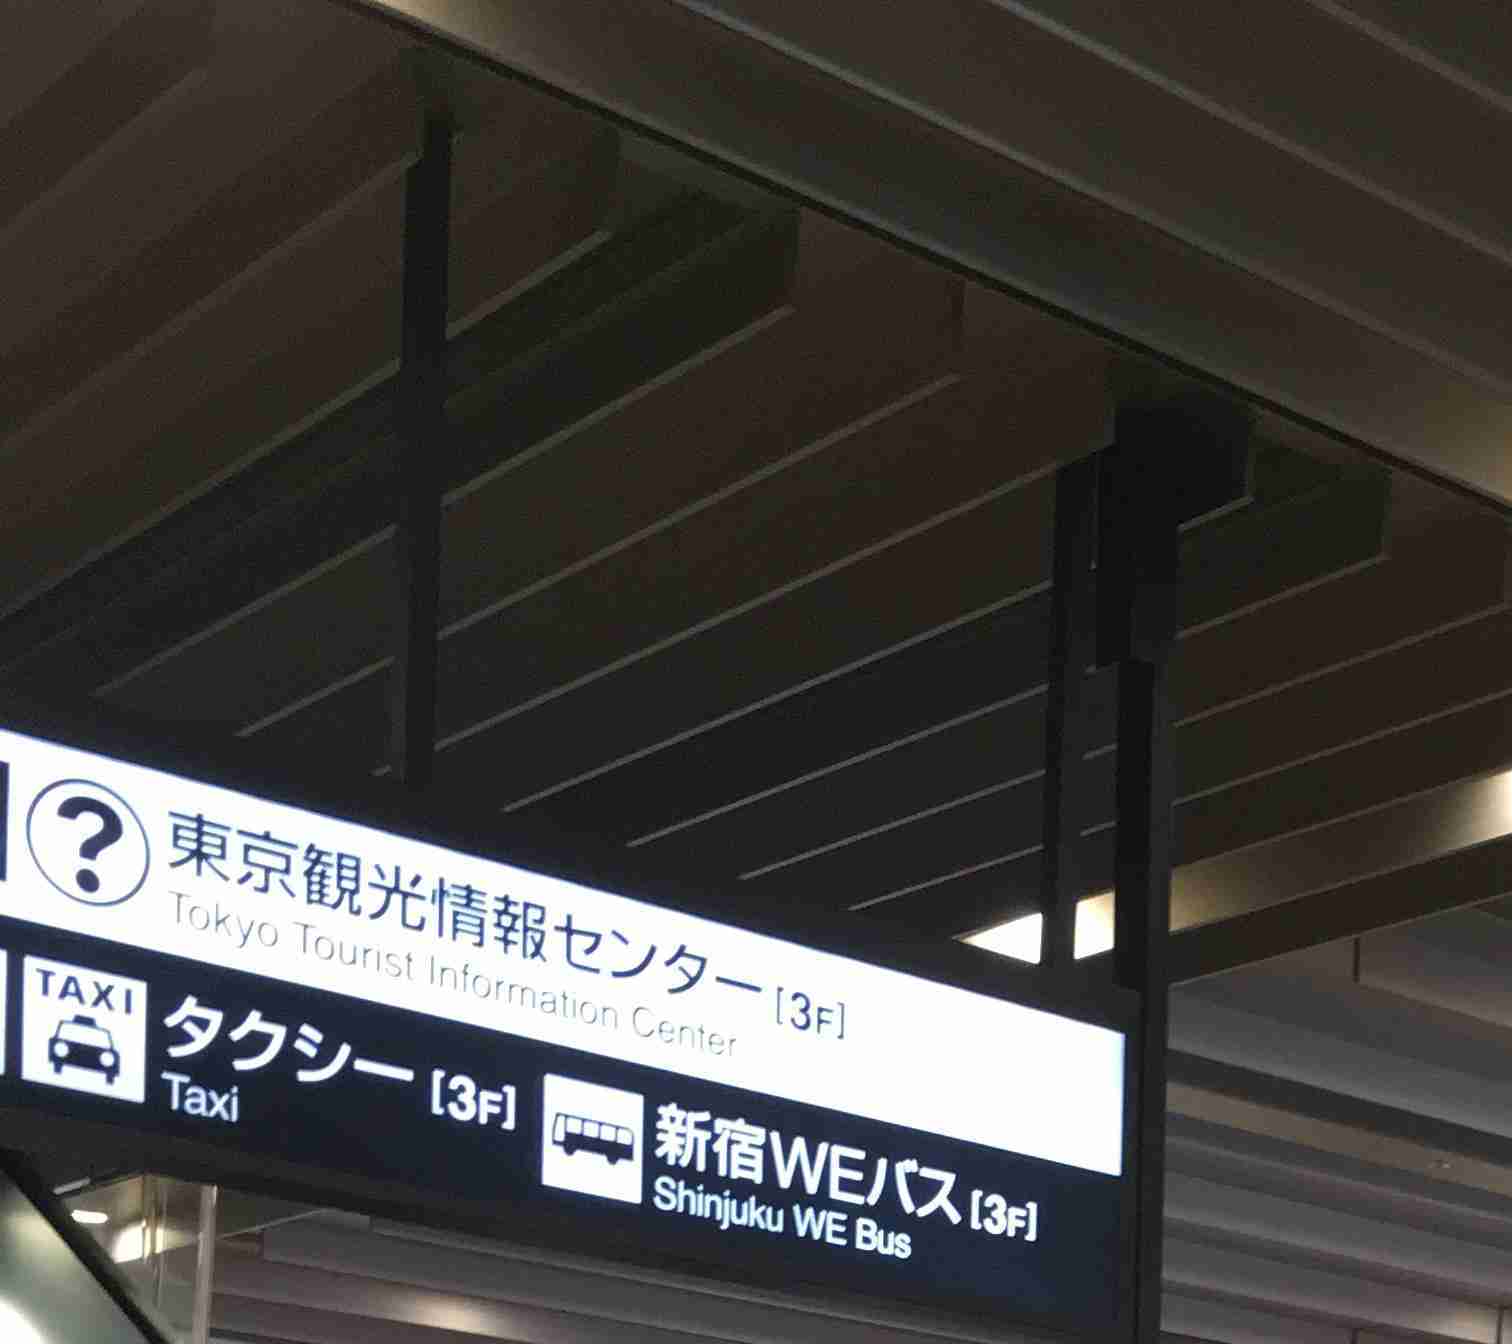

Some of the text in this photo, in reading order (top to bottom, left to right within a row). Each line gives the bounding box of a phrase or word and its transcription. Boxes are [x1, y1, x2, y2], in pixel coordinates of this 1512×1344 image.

[35, 968, 132, 1015] TAXI
[167, 809, 845, 1039] 東京観光情報センター [3F]
[168, 891, 737, 1057] Tokyo Tourist Information Center
[160, 1071, 240, 1123] Taxi
[162, 995, 516, 1130] タクシー [3F]
[652, 1176, 912, 1259] Shinjuku WE Bus
[654, 1103, 1038, 1242] 新宿WEバス [3F]
